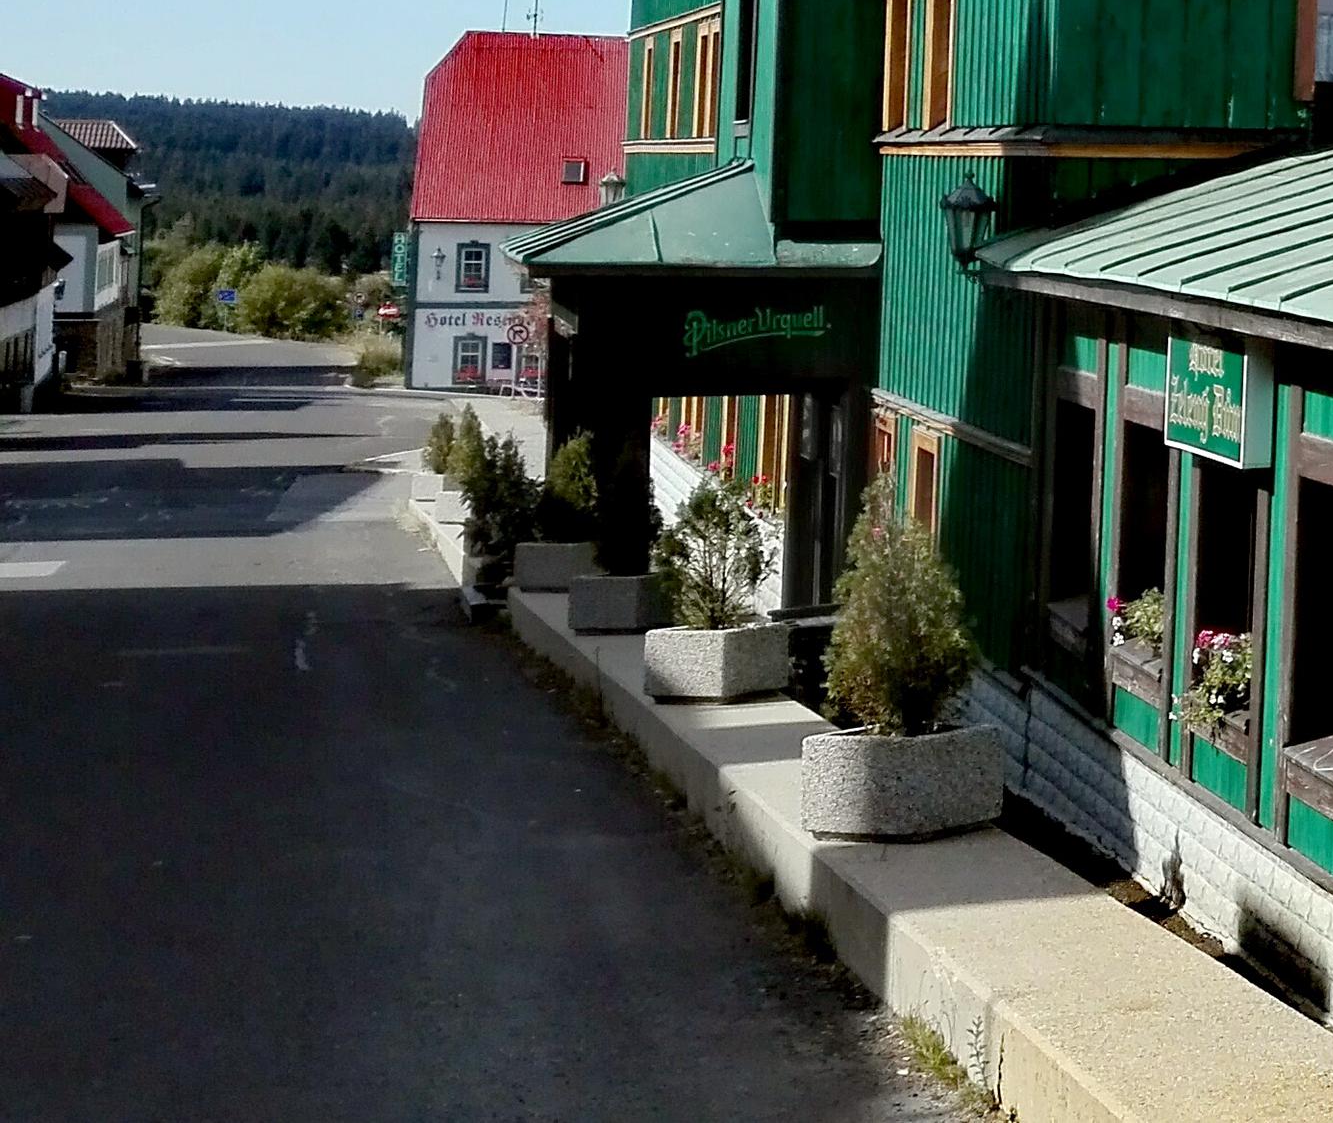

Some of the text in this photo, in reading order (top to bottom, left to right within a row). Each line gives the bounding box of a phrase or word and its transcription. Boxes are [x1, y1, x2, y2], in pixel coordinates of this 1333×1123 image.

[393, 233, 407, 282] HOTEL
[424, 311, 466, 328] Hotel
[683, 310, 755, 357] Pilsner
[1188, 341, 1224, 381] Hotel
